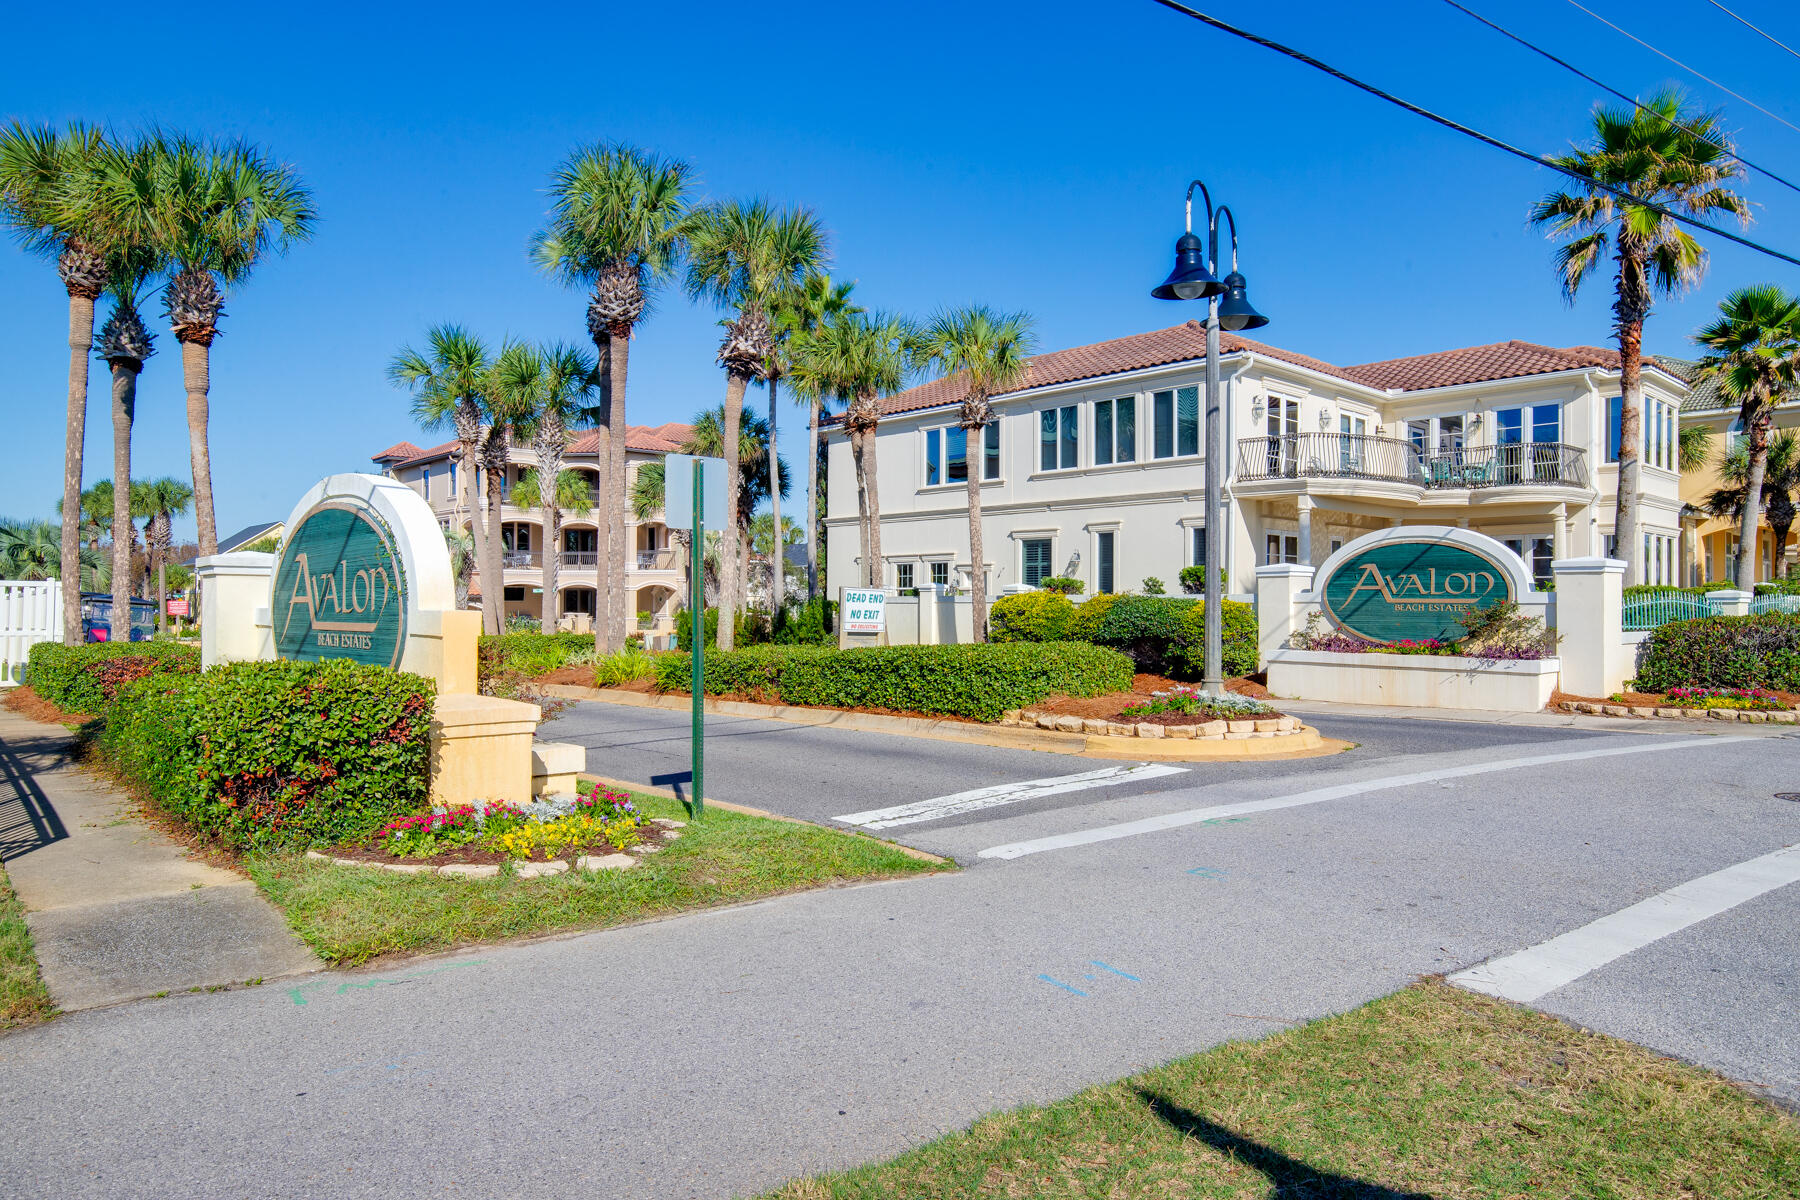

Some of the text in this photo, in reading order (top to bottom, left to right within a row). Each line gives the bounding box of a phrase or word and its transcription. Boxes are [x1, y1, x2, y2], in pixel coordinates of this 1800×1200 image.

[846, 593, 884, 603] DEAD END
[1395, 604, 1469, 612] BEACH ESTATES
[850, 610, 880, 619] NO EXIT
[317, 632, 372, 650] BEACH ESTATES
